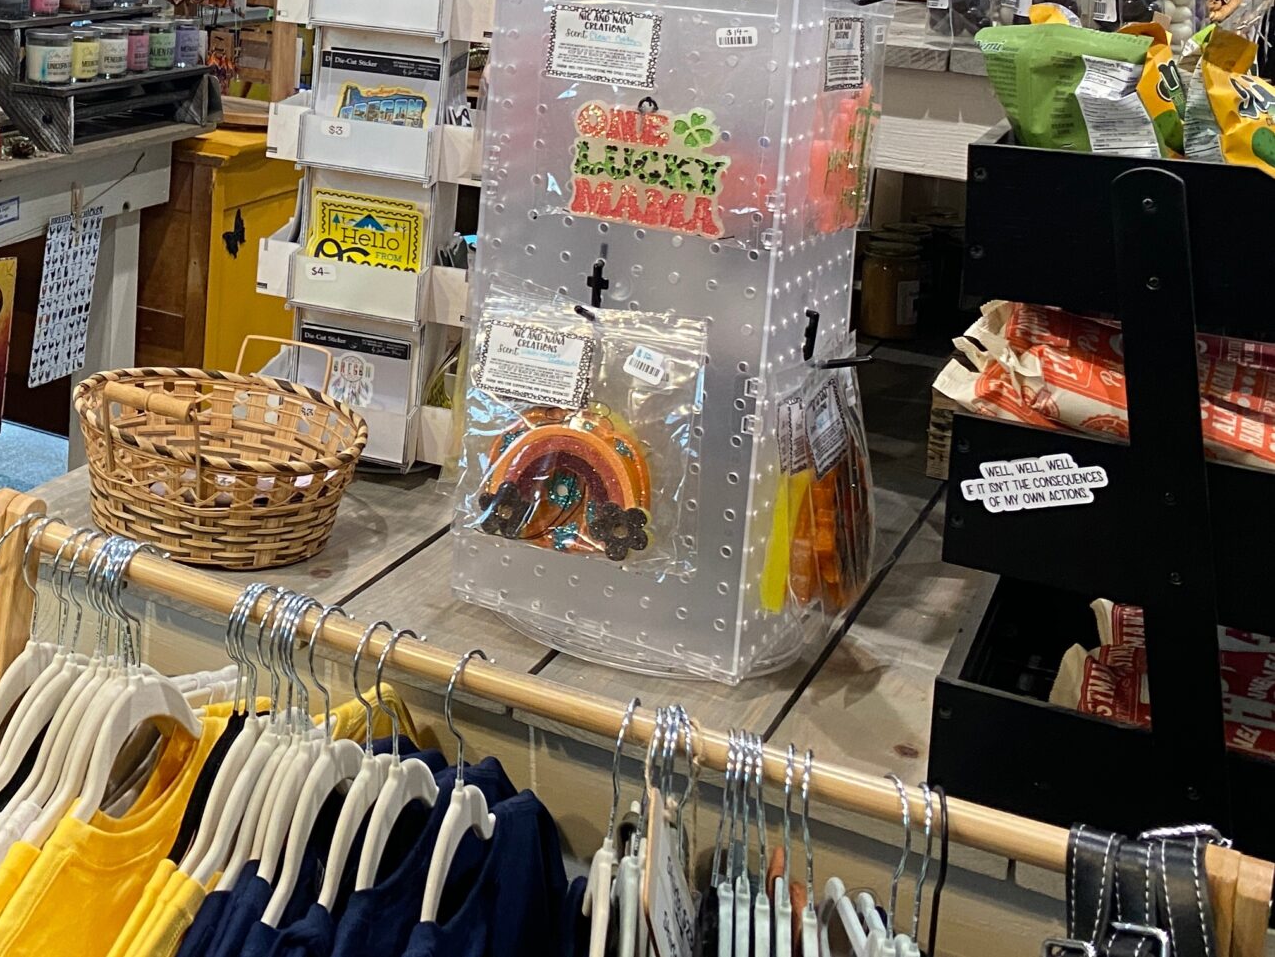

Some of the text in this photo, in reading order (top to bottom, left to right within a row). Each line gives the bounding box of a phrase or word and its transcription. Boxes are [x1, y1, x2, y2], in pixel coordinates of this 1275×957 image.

[578, 11, 634, 26] NIC AND NANA
[584, 22, 627, 34] CREATIONS
[334, 56, 377, 67] Die-Cut Sticker
[328, 125, 343, 136] $3
[577, 103, 670, 147] ONE
[574, 140, 726, 196] LUCKY
[570, 177, 720, 236] MAMA
[50, 214, 72, 224] BREEDS
[340, 227, 400, 251] Hello
[375, 251, 403, 263] FROM
[327, 335, 347, 344] Sticker
[512, 328, 565, 345] NIC AND NANA
[516, 338, 558, 354] CREATIONS
[984, 458, 1073, 477] WELL, WELL, WELL
[965, 471, 1104, 495] IF IT ISN'T THE CONSEQUENCES
[988, 488, 1089, 508] OF MY OWN ACTIONS.
